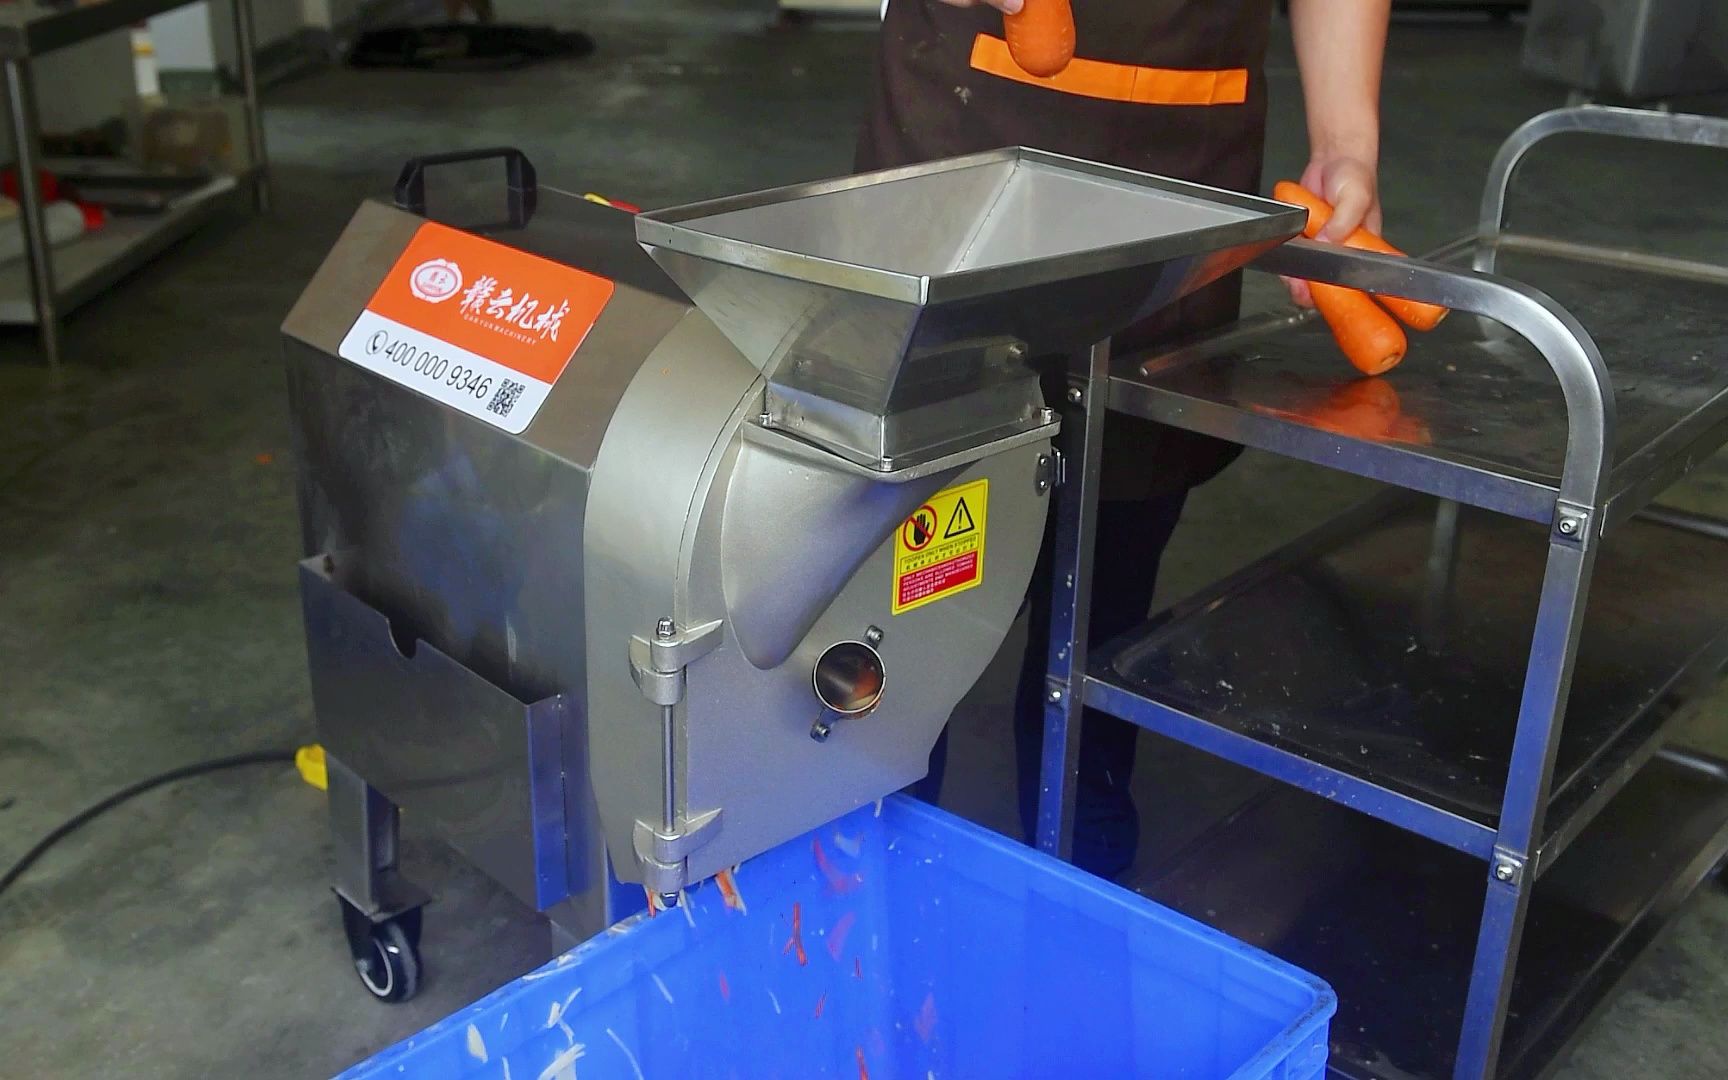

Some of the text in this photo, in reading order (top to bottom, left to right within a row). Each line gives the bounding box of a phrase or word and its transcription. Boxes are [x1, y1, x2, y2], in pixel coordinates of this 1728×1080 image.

[460, 275, 570, 342] 赣云机械
[493, 324, 537, 346] MACHINERY
[384, 340, 492, 399] 400 000 9346
